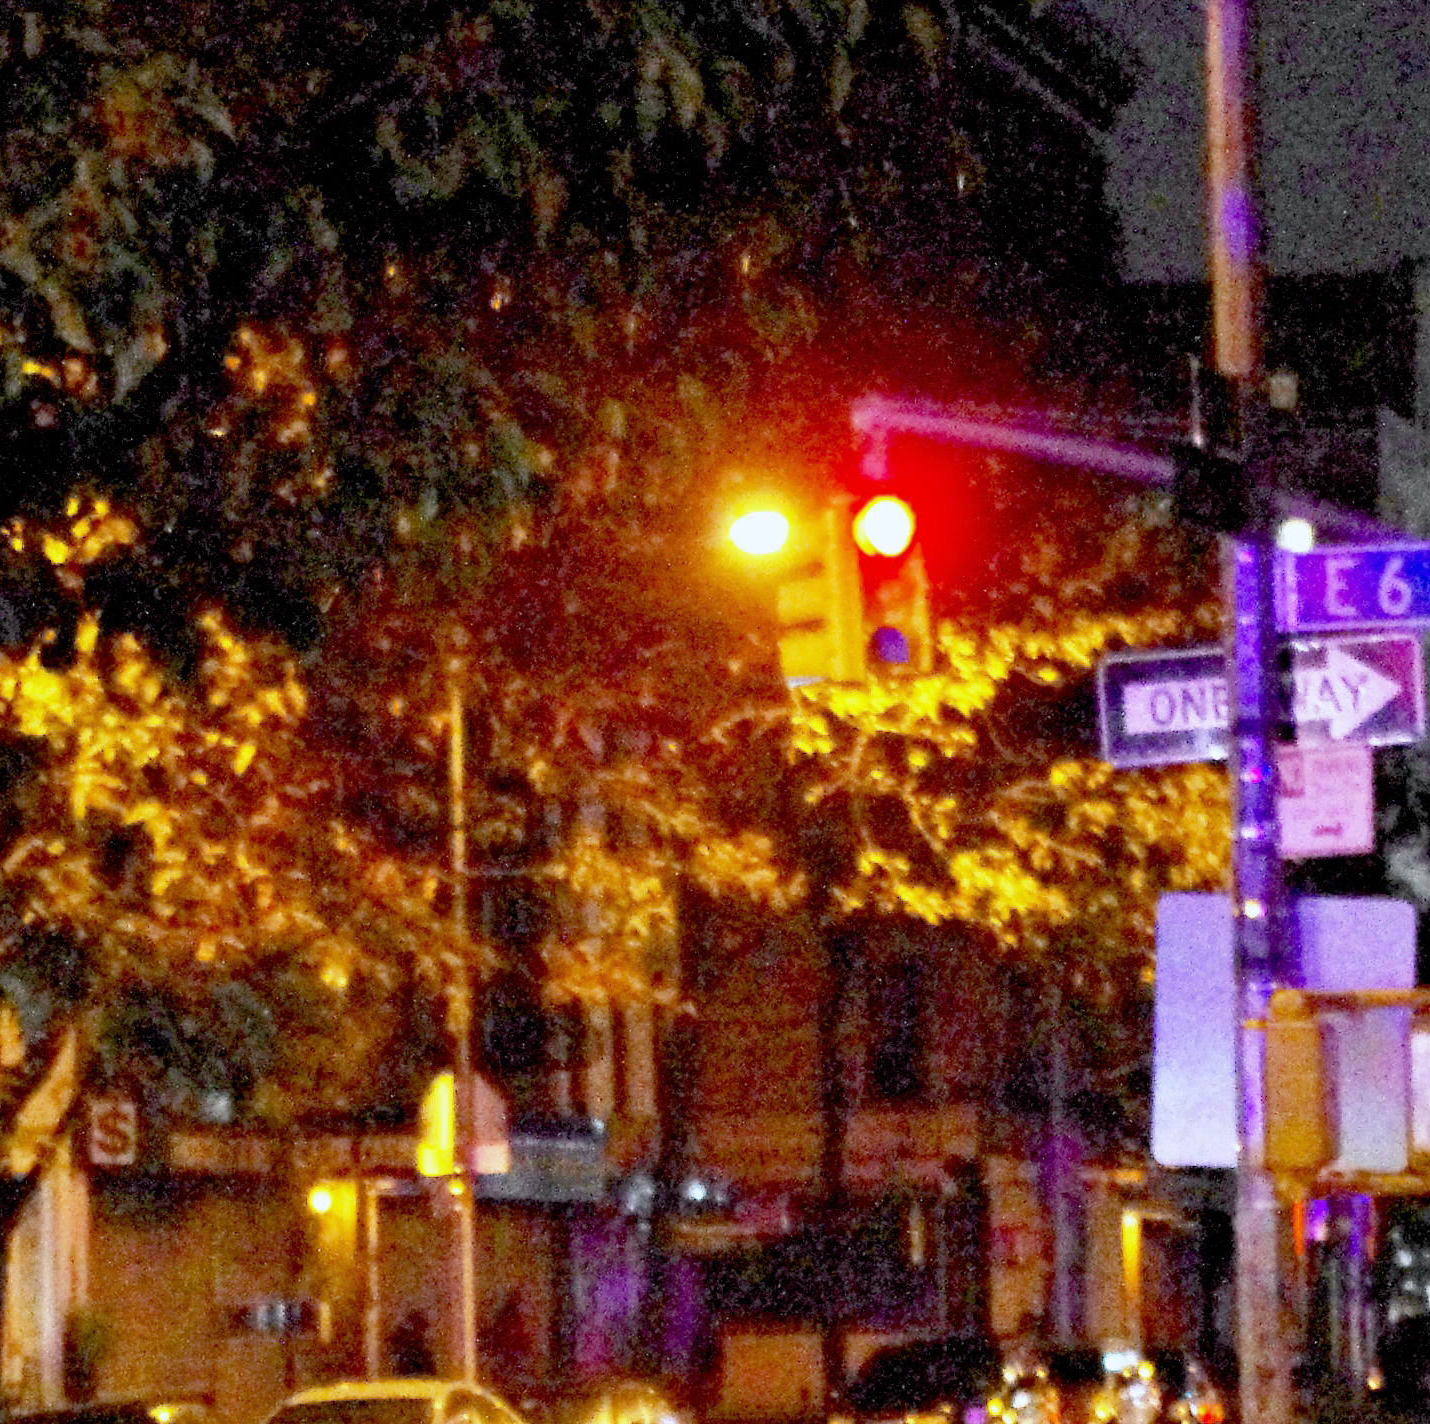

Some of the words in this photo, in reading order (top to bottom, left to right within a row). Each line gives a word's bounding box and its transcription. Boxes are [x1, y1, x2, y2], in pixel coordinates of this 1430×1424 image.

[1324, 558, 1359, 616] E
[1378, 556, 1413, 616] 6
[1149, 683, 1228, 727] ONE
